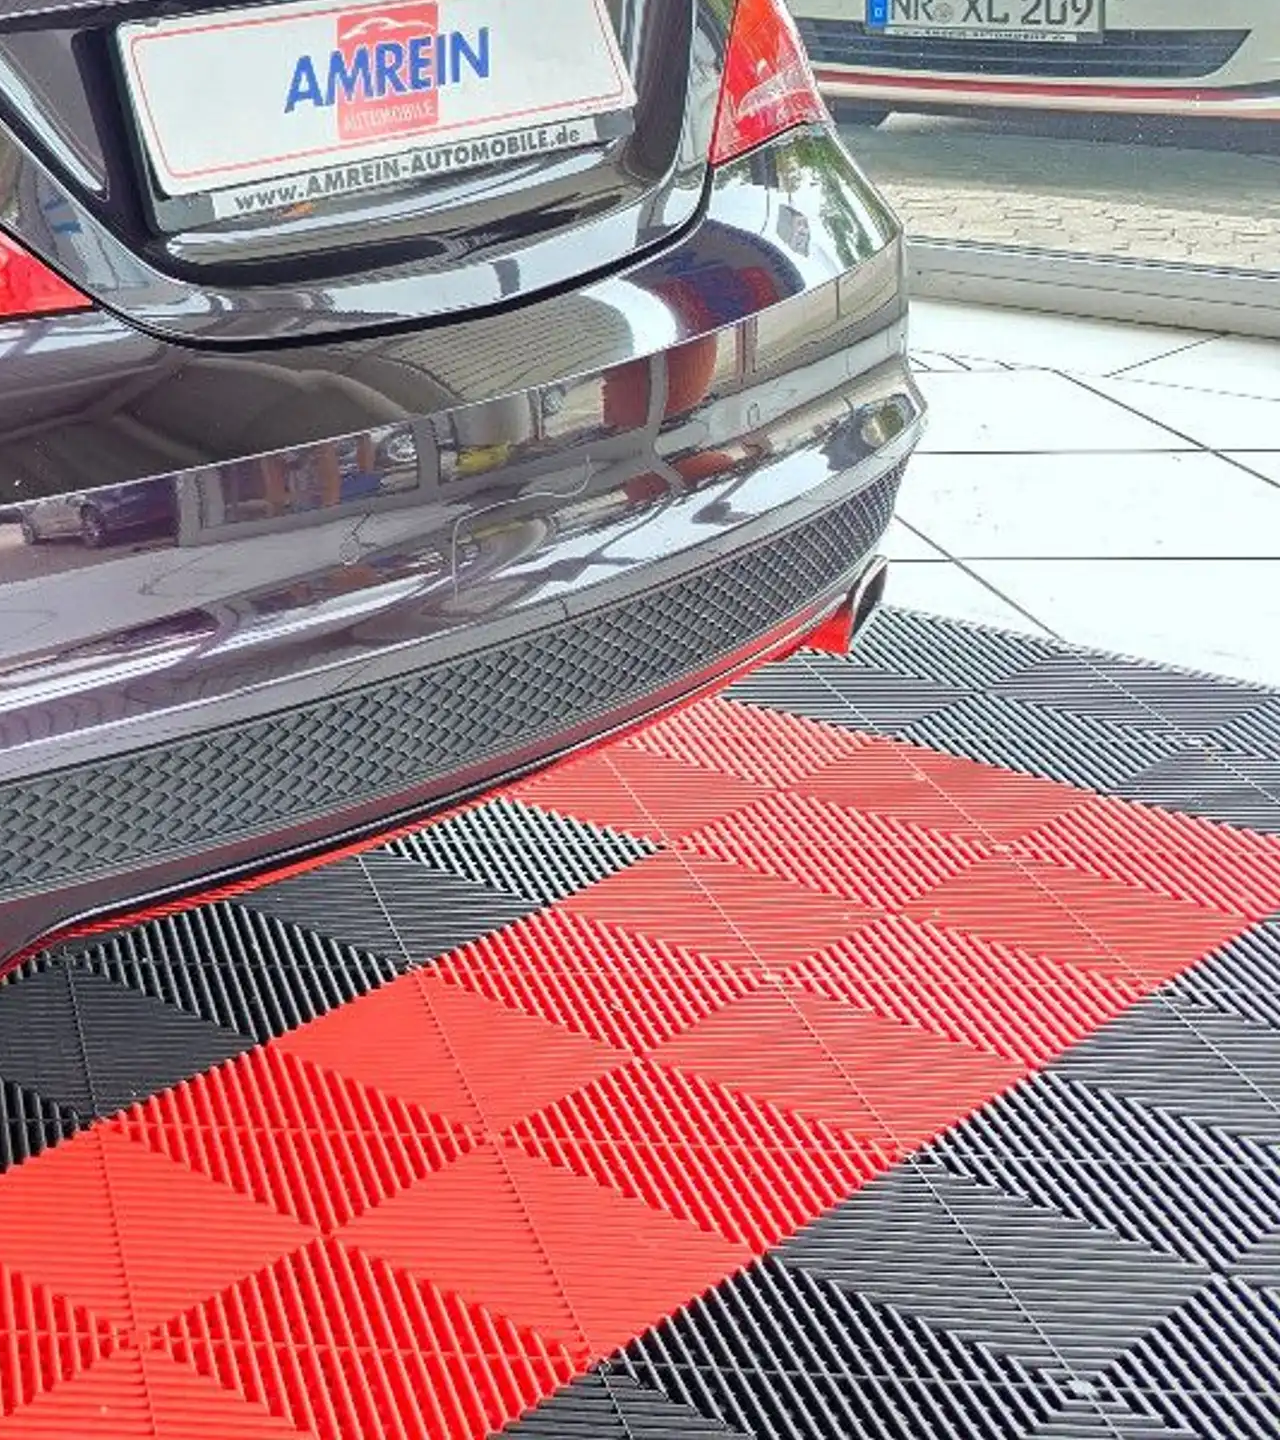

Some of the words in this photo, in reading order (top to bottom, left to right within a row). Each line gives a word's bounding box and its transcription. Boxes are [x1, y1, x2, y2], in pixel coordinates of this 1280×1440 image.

[283, 25, 491, 115] AMREIN
[342, 98, 435, 134] AUTOMOBILE
[233, 125, 582, 211] www.AMREIN-AUTOMOBILE.de
